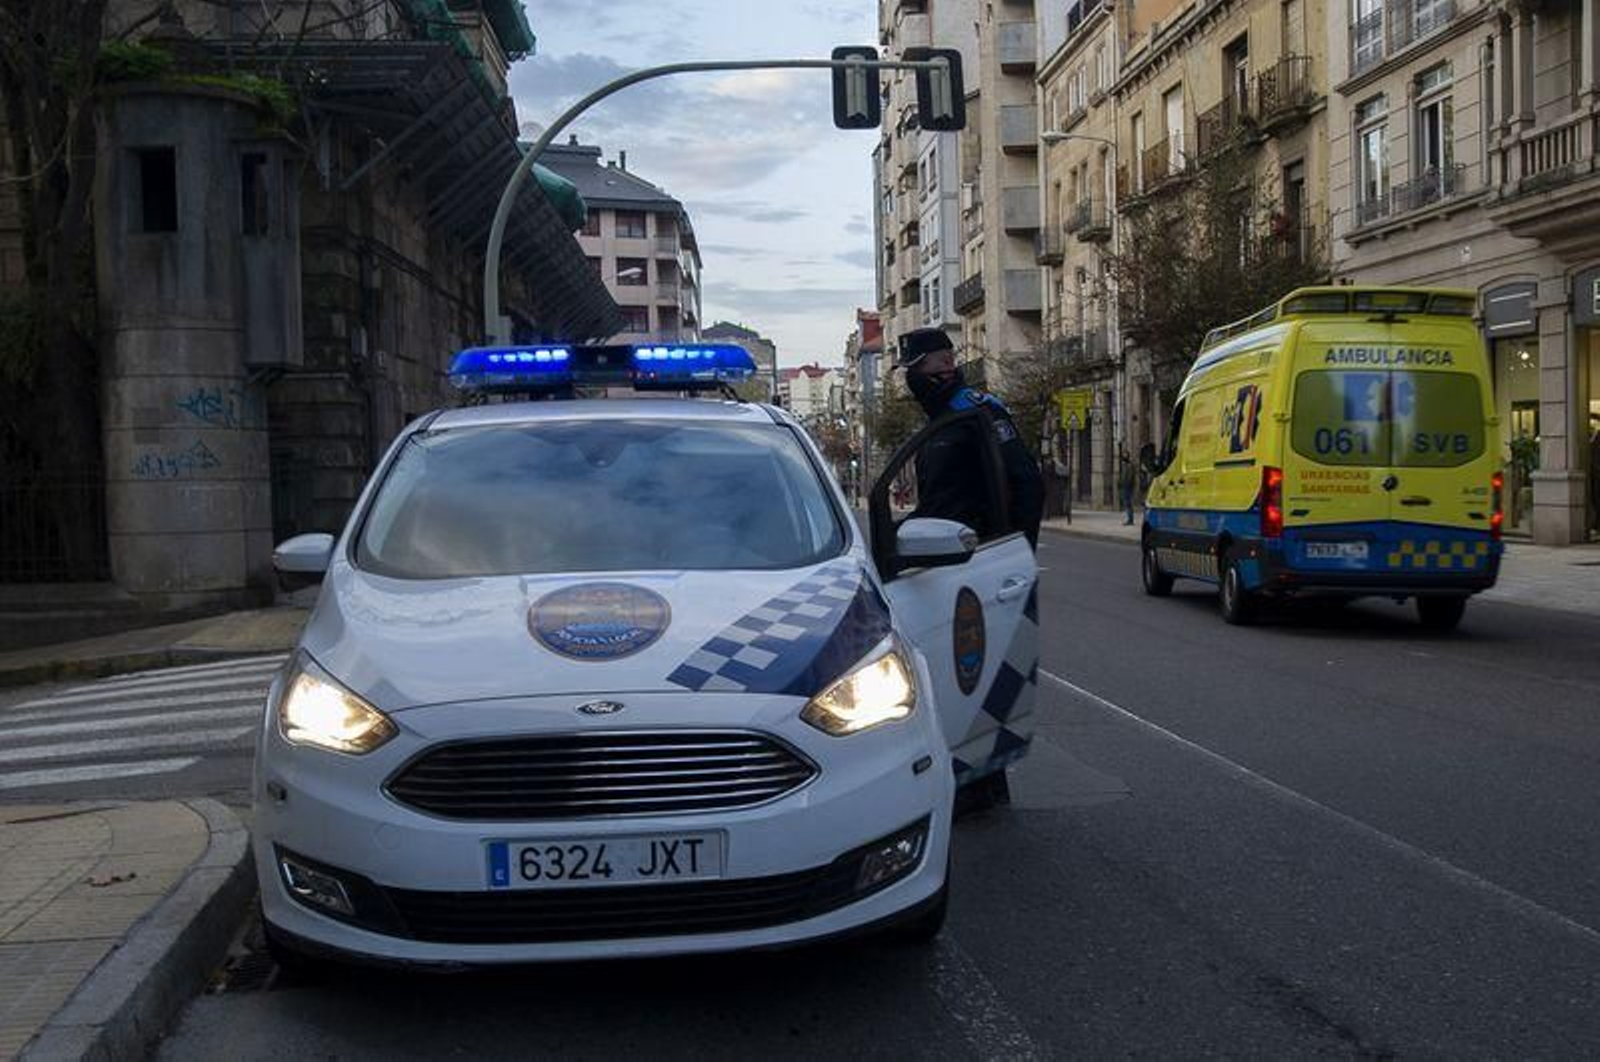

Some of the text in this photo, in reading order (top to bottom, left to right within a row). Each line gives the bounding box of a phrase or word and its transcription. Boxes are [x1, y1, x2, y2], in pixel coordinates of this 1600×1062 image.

[1325, 347, 1455, 366] AMBULANCIA
[1314, 427, 1370, 455] 061
[1300, 484, 1371, 494] SANITARIAS
[519, 844, 614, 881] 6324
[637, 839, 704, 877] JXT
